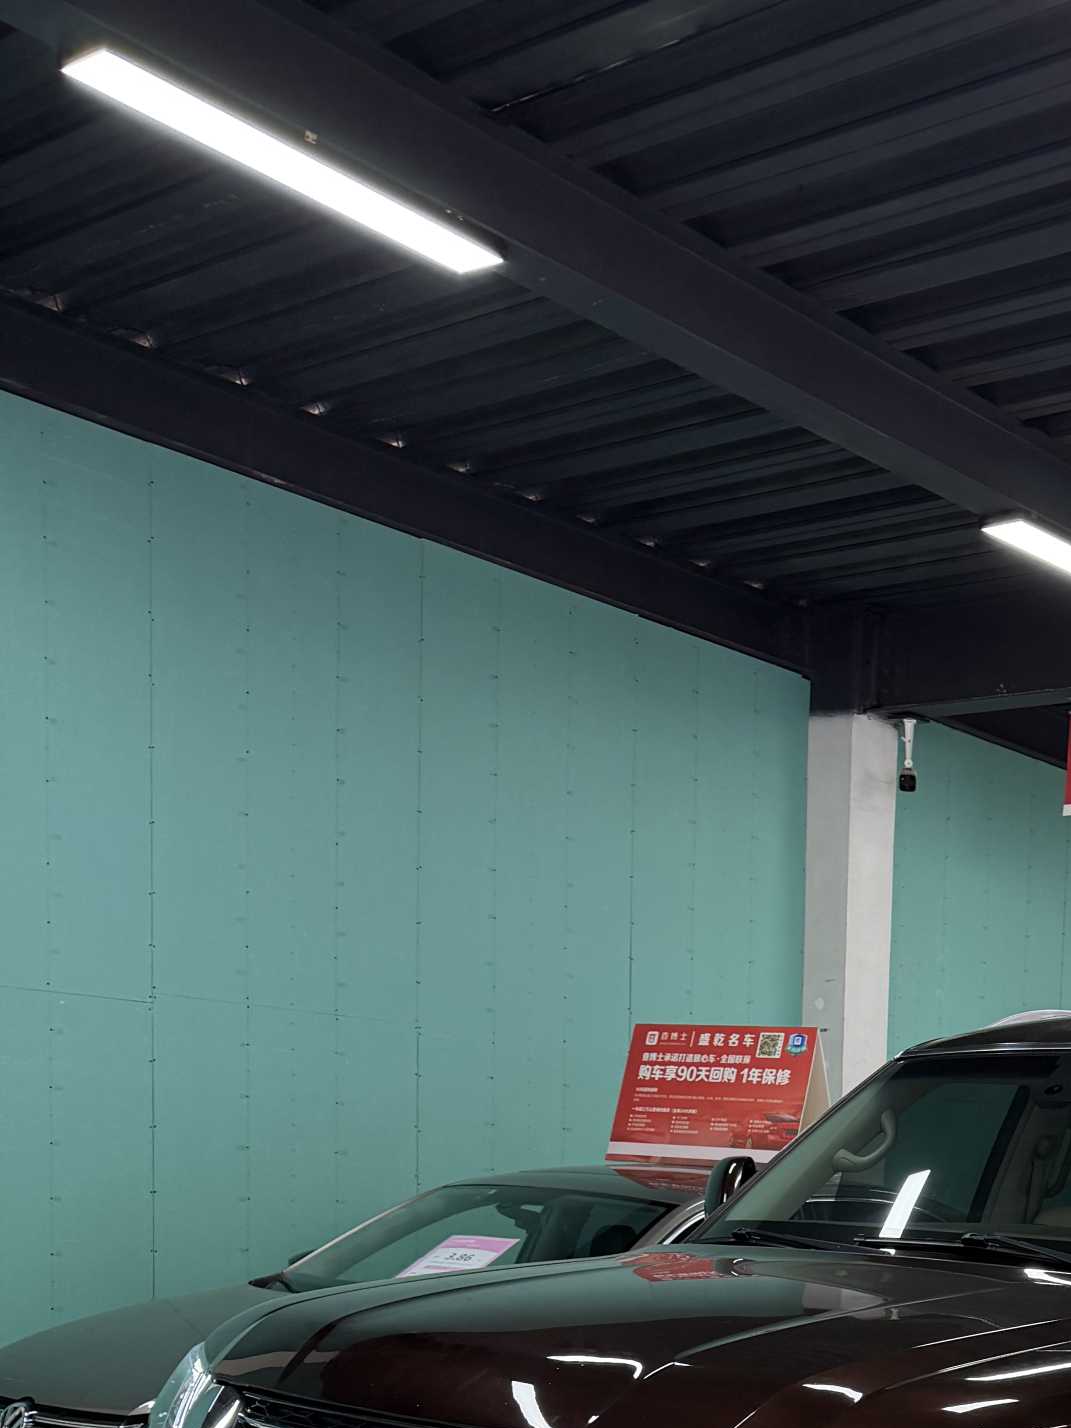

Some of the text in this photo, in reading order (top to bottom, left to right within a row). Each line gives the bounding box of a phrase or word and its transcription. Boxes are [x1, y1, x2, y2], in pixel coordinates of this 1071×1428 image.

[637, 1064, 792, 1087] 购车享90天回购 1年保修
